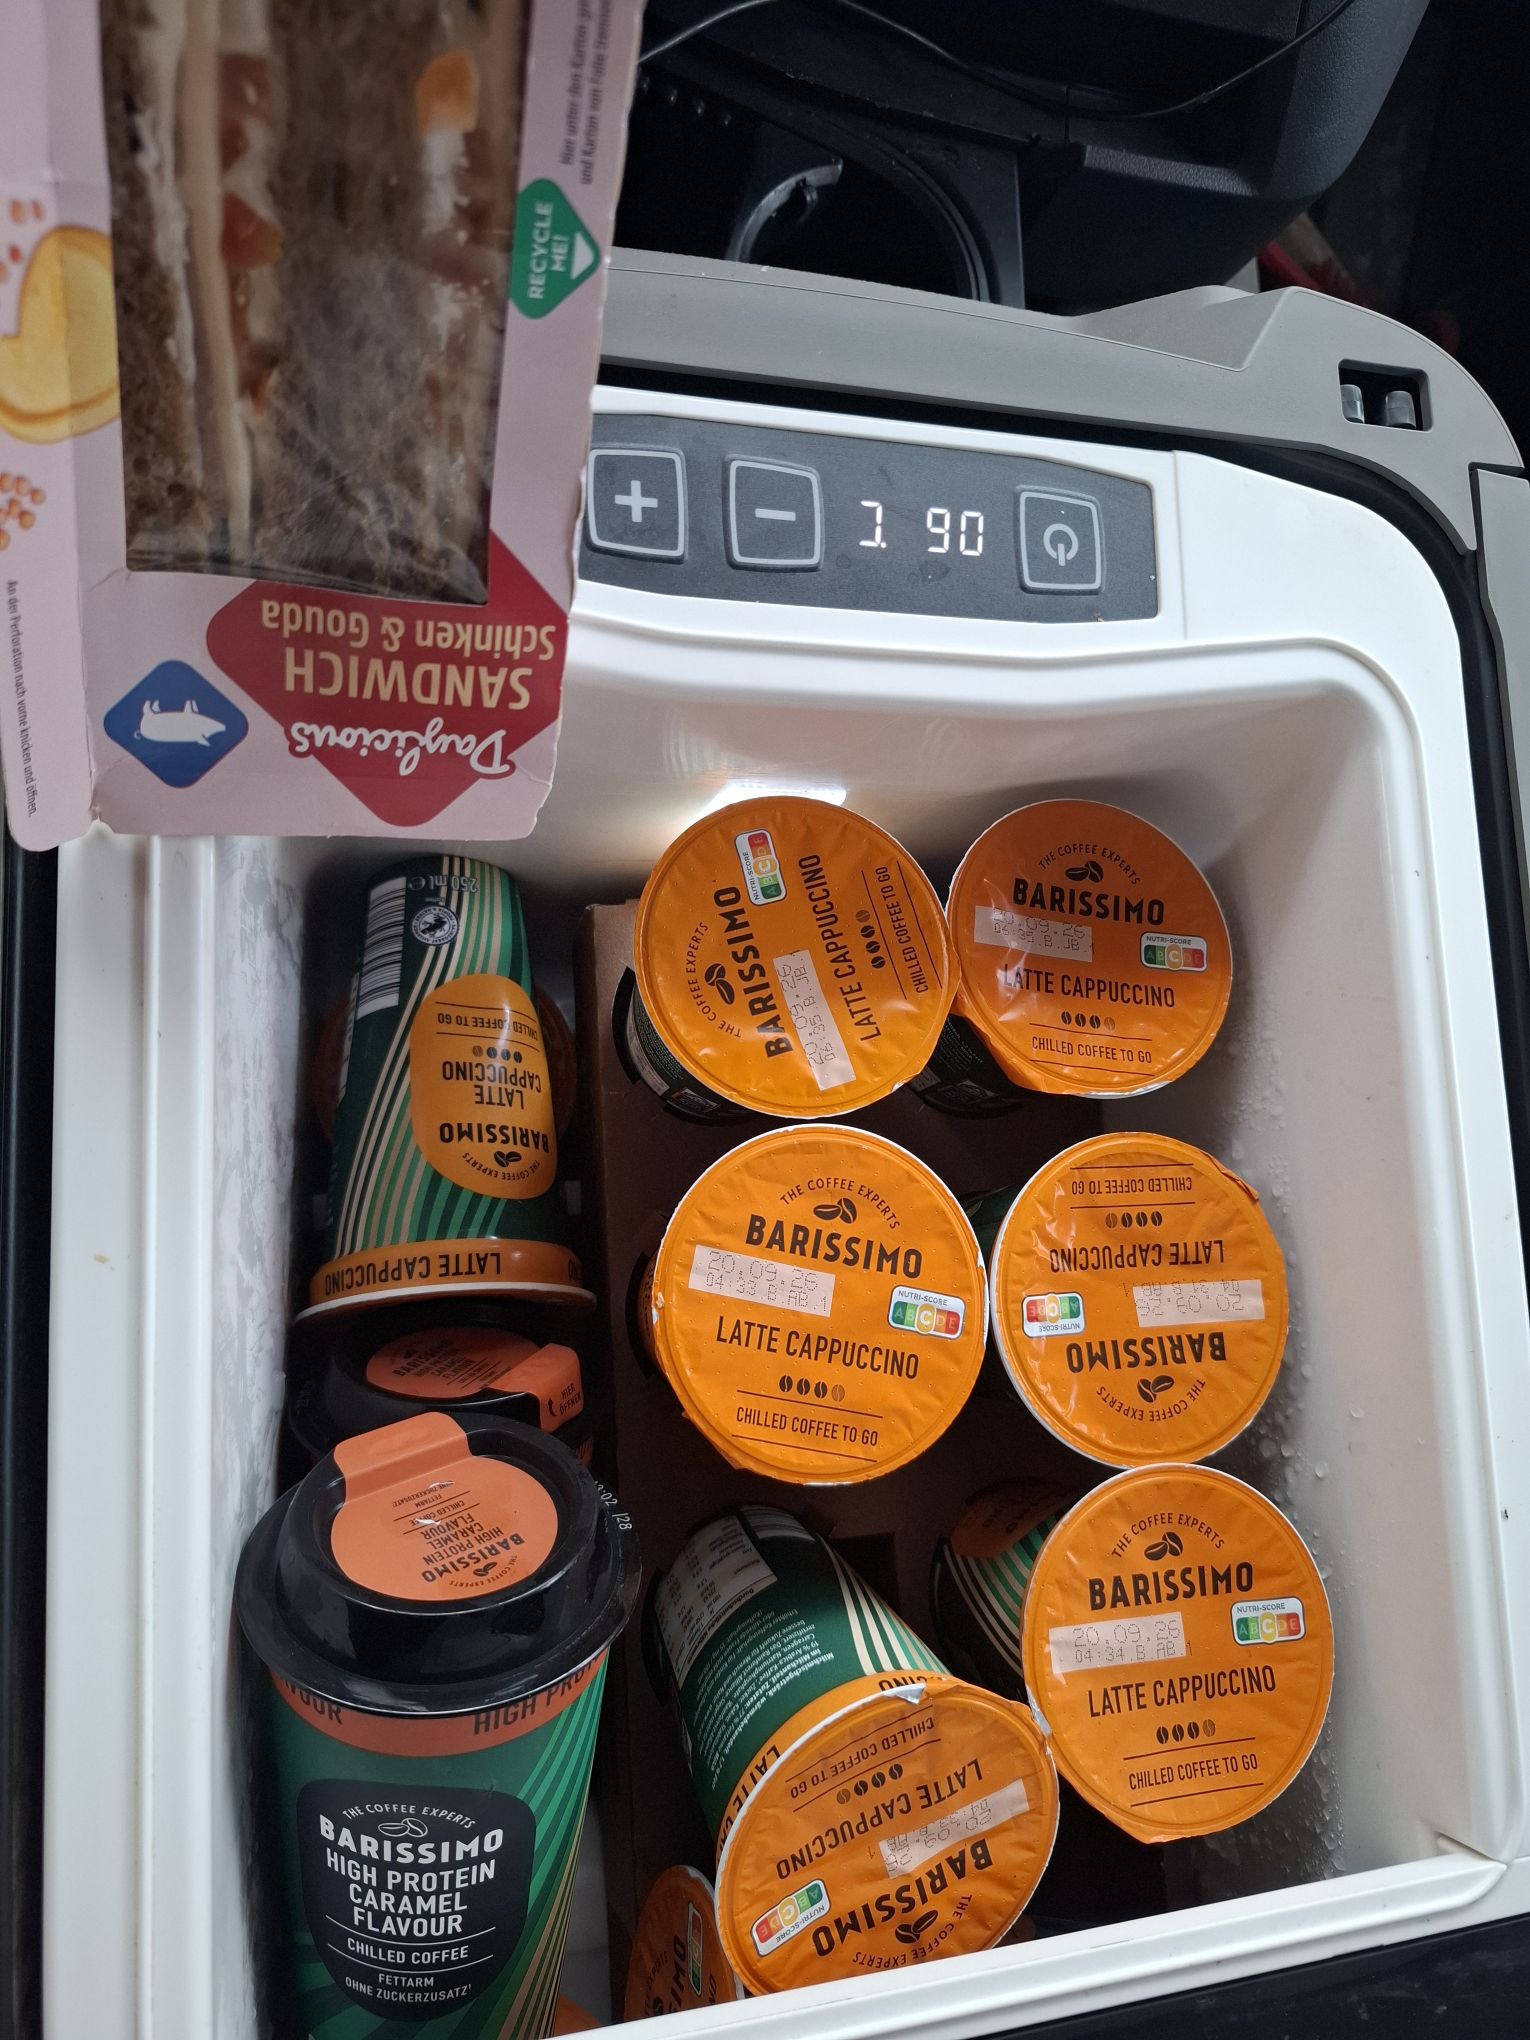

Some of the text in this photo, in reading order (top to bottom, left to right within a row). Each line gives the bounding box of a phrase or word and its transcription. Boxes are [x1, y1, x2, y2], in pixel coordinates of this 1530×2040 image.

[528, 200, 553, 301] RECYCLE
[550, 234, 570, 273] ME!
[926, 506, 984, 557] 90
[261, 600, 557, 660] Schinken & Gouda
[5, 579, 37, 818] An der Perforation nach vorne knicken und öffnen.
[284, 646, 532, 710] SANDWICH
[291, 717, 512, 777] Daylicious
[428, 873, 478, 894] 250 ml
[742, 851, 761, 901] NUTRI-SCORE
[1038, 843, 1141, 886] THE COFFEE EXPERTS
[1012, 877, 1165, 926] BARISSIMO
[798, 854, 882, 1042] LATTE CAPPUCCINO
[876, 866, 929, 994] CHILLED COFFEE TO GO
[1146, 935, 1192, 946] NUTRI-SCORE
[685, 920, 742, 1039] THE COFFEE EXPERTS
[713, 886, 794, 1058] BARISSIMO
[1003, 964, 1175, 1008] LATTE CAPPUCCINO
[437, 1011, 453, 1026] GO
[454, 1012, 469, 1027] TO
[512, 1020, 538, 1041] CHILLED
[1032, 1036, 1152, 1064] CHILLED COFFEE TO GO
[441, 1060, 542, 1093] CAPPUCCINO
[474, 1085, 525, 1110] LATTE
[439, 1121, 550, 1154] BARISSIMO
[461, 1151, 499, 1180] EXPERTS
[1071, 1176, 1193, 1196] CHILLED COFFEE TO GO
[779, 1176, 900, 1231] THE COFFEE EXPERTS
[745, 1214, 923, 1280] BARISSIMO
[1049, 1239, 1225, 1274] LATTE CAPPUCCINO
[324, 1251, 500, 1297] LATTE CAPPUCCINO
[897, 1289, 948, 1307] NUTRI-SCORE
[715, 1315, 920, 1380] LATTE CAPPUCCINO
[1039, 1323, 1081, 1333] NUTRI-SCORE
[1065, 1331, 1227, 1375] BARISSIMO
[559, 1392, 582, 1415] ÖFFNEN
[560, 1383, 576, 1399] HIER
[1095, 1378, 1206, 1423] THE COFFEE EXPERTS
[735, 1406, 879, 1447] CHILLED COFFEE TO GO
[414, 1493, 444, 1508] FETTARM
[436, 1499, 466, 1516] CHILLED
[421, 1512, 475, 1540] FLAVOUR
[422, 1526, 505, 1567] HIGH PROTEIN
[426, 1524, 485, 1550] CARAMEL
[1111, 1512, 1225, 1559] THE COFFEE EXPERTS
[420, 1532, 526, 1584] BARISSIMO
[448, 1578, 486, 1589] EXPERTS
[1088, 1561, 1254, 1612] BARISSIMO
[1236, 1601, 1286, 1614] NUTRI-SCORE
[742, 1652, 811, 1710] Milchanteil. Zutaten:
[763, 1650, 834, 1698] Milchmischgetränk,
[1088, 1664, 1277, 1718] LATTE CAPPUCCINO
[473, 1700, 537, 1735] HIGH
[789, 1716, 935, 1799] CHILLED COFFEE TO GO
[1128, 1753, 1259, 1791] CHILLED COFFEE TO GO
[915, 1759, 985, 1810] LATTE
[342, 1803, 476, 1830] THE COFFEE EXPERTS
[776, 1791, 913, 1881] CAPPUCCINO
[319, 1813, 504, 1866] BARISSIMO
[325, 1847, 496, 1894] HIGH PROTEIN
[348, 1882, 468, 1916] CARAMEL
[811, 1838, 994, 1957] BARISSIMO
[353, 1906, 463, 1938] FLAVOUR
[775, 1903, 825, 1944] NUTRI-SCORE
[852, 1893, 972, 1969] THE COFFEE EXPERTS
[347, 1937, 470, 1965] CHILLED COFFEE
[344, 1975, 374, 1997] OHNE
[378, 1972, 434, 1988] FETTARM
